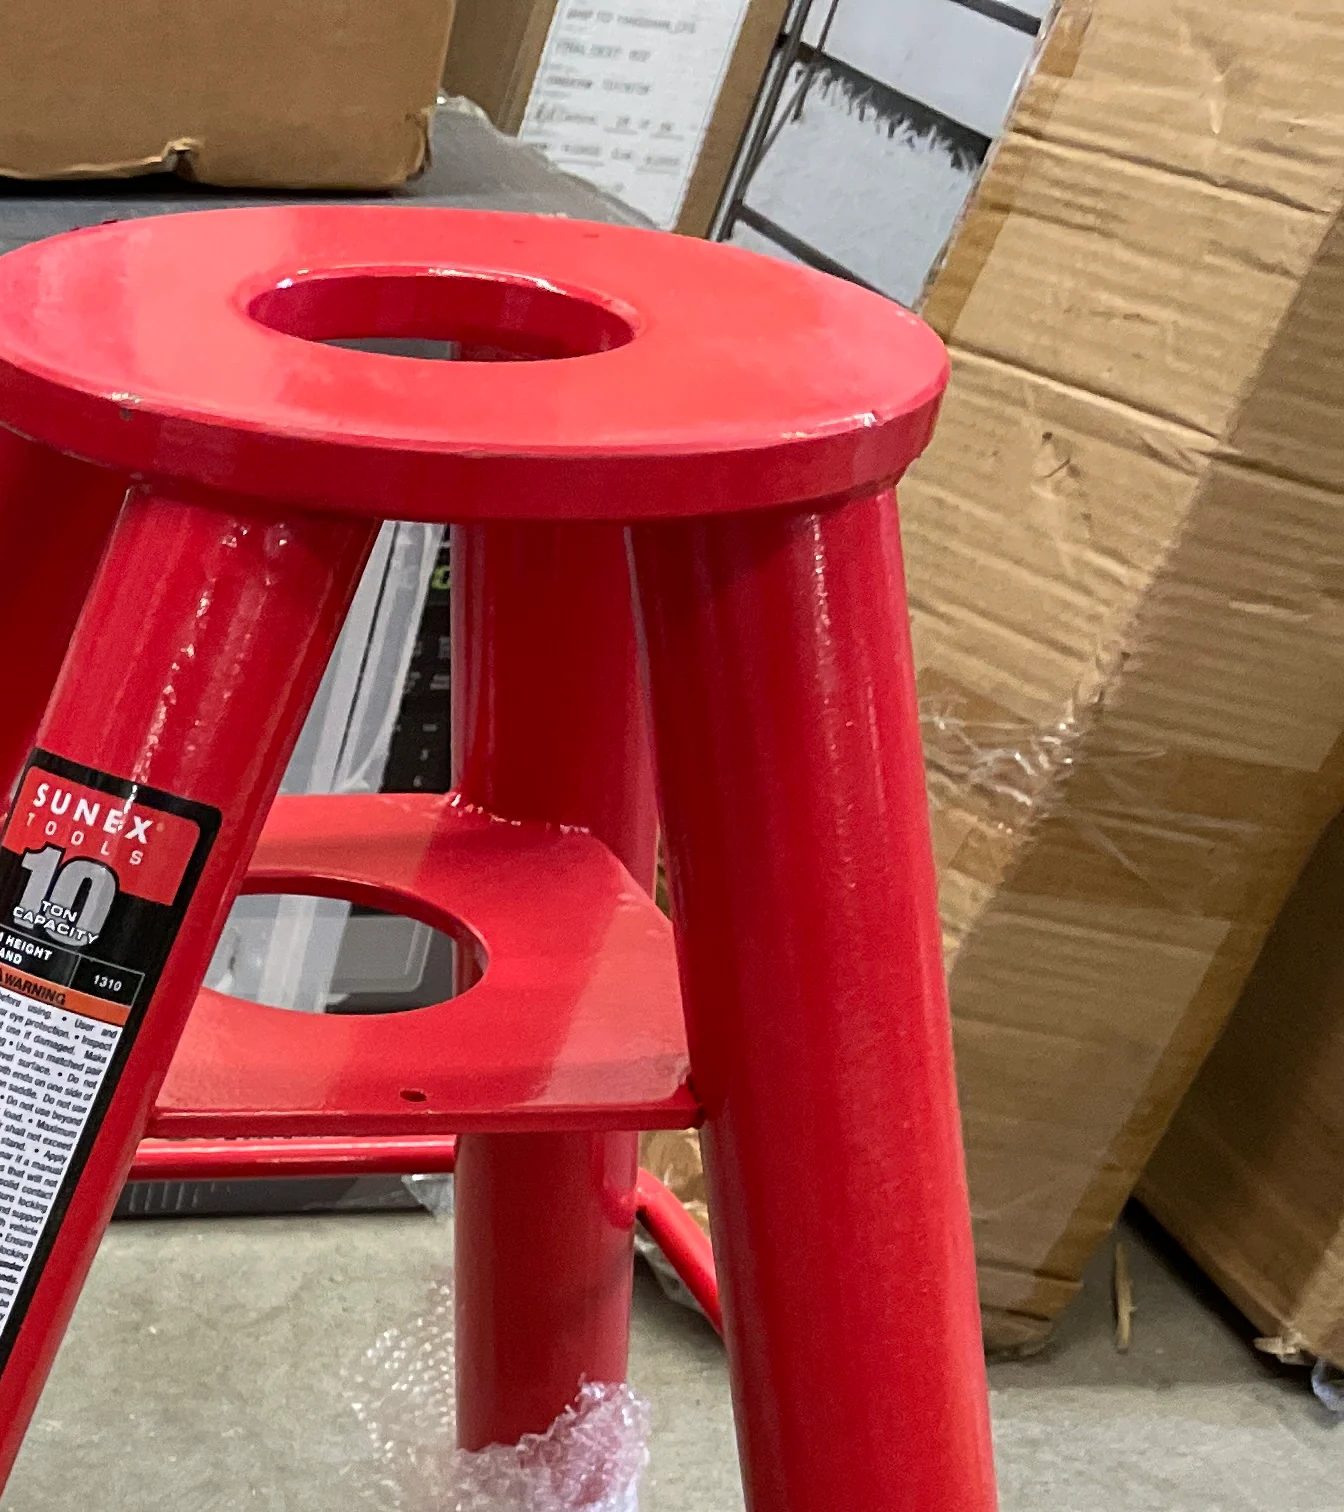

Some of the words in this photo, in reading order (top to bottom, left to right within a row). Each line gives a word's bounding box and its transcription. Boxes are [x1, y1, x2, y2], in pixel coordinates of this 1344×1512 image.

[32, 783, 153, 844] SUNEX
[26, 812, 144, 865] TOOLS
[20, 843, 120, 947] 10
[40, 899, 79, 923] TON
[12, 905, 100, 945] CAPACITY
[5, 934, 53, 961] HEIGHT
[3, 972, 68, 1007] WARNING
[94, 974, 122, 992] 1310
[23, 1018, 70, 1040] protection.
[80, 1034, 113, 1052] Inspect
[74, 1018, 95, 1032] User
[100, 1028, 118, 1040] and
[33, 1035, 76, 1056] damaged.
[83, 1049, 108, 1064] Make
[17, 1058, 51, 1076] surface.
[66, 1072, 80, 1085] Do
[82, 1079, 98, 1090] not
[45, 1053, 86, 1072] matched
[84, 1066, 103, 1076] pair
[42, 1093, 56, 1105] Do
[55, 1099, 72, 1111] not
[71, 1104, 88, 1114] use
[63, 1087, 83, 1099] side
[82, 1093, 94, 1102] of
[35, 1118, 78, 1139] Maximum
[51, 1109, 84, 1127] beyond
[42, 1137, 74, 1152] exceed
[30, 1160, 64, 1176] manual
[43, 1149, 68, 1166] Apply
[21, 1185, 54, 1201] contact
[43, 1178, 59, 1189] not
[17, 1196, 49, 1215] locking
[11, 1209, 44, 1225] support
[4, 1232, 34, 1249] Ensure
[8, 1223, 39, 1237] vehicle
